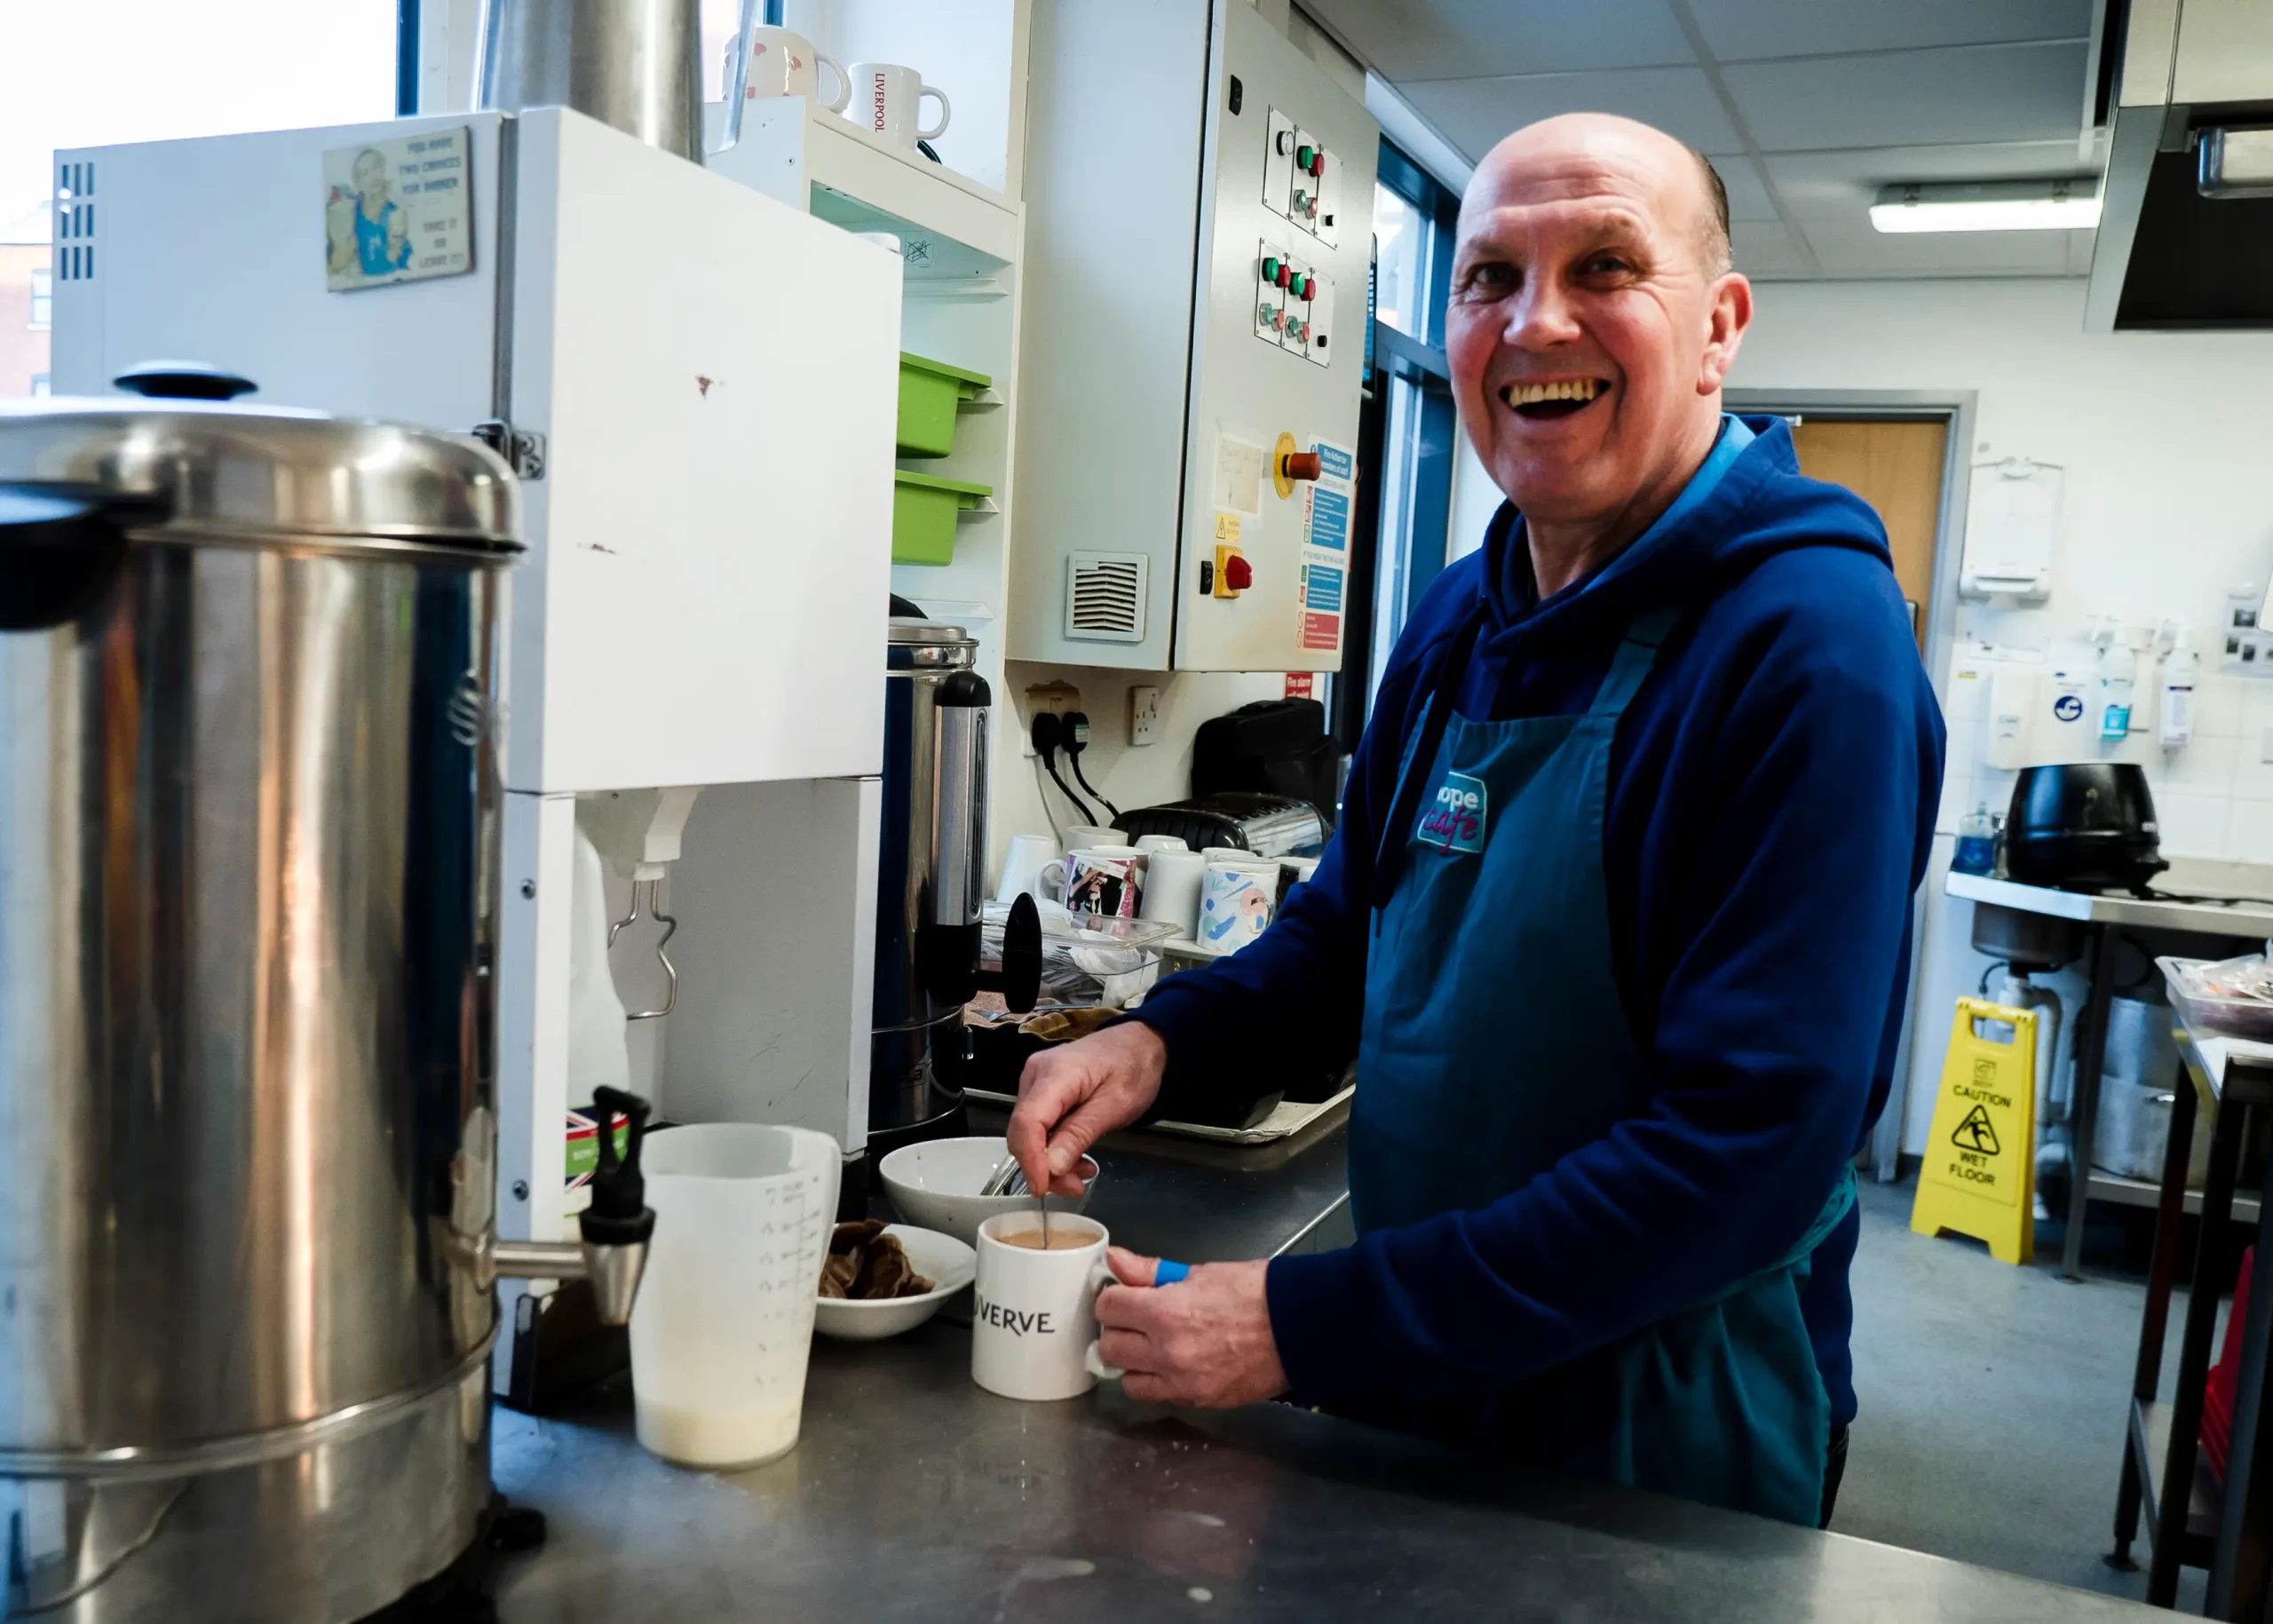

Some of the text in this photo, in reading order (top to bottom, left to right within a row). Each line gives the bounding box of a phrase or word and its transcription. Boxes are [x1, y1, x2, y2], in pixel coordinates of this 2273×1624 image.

[875, 73, 885, 133] LIVERPOOL
[1437, 786, 1478, 812] ope
[1952, 1084, 2013, 1108] CAUTION
[1960, 1151, 1988, 1168] WET
[1949, 1162, 1996, 1186] FLOOR
